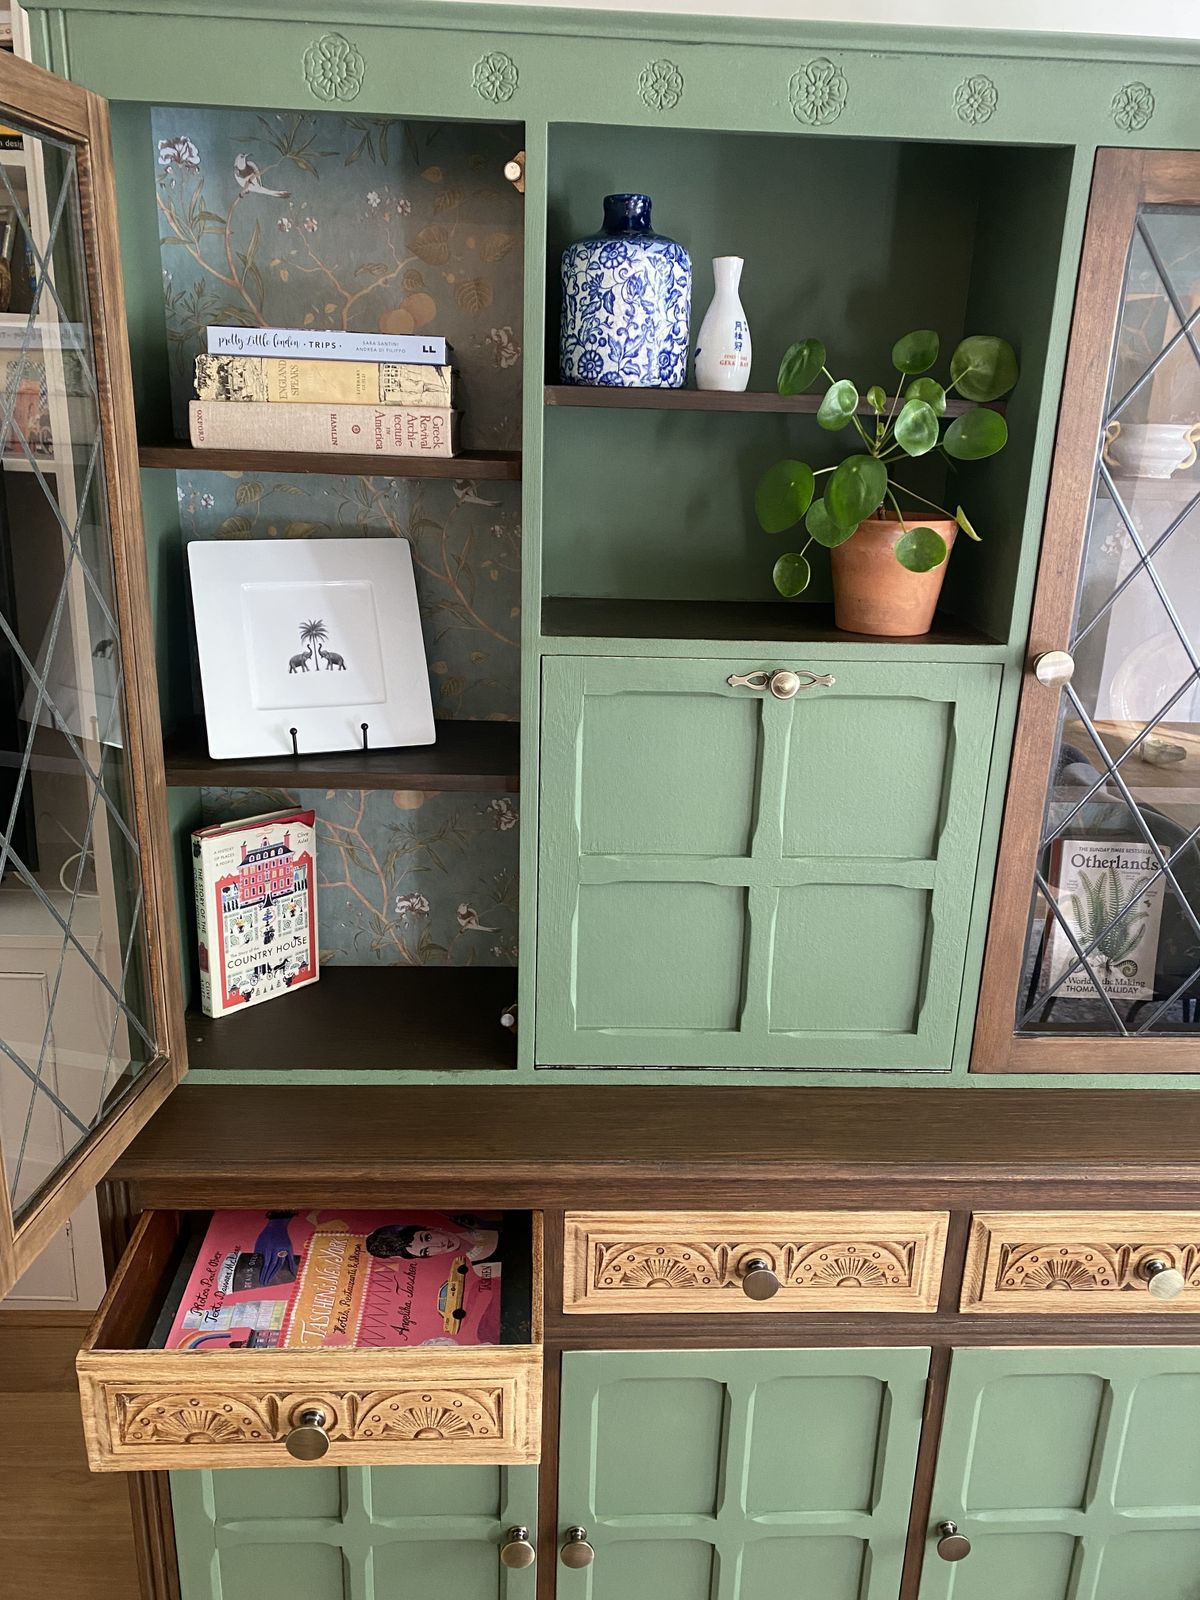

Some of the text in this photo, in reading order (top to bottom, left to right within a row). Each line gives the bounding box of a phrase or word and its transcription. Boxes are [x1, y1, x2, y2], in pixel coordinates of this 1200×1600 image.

[308, 341, 337, 349] TRIPS
[422, 345, 436, 353] LL
[278, 360, 288, 400] ENGLAND
[290, 364, 299, 396] SPEAKS
[197, 409, 205, 442] OXFORD
[330, 413, 338, 446] HAMLIN
[374, 409, 386, 450] America
[394, 414, 403, 447] tecture
[420, 415, 432, 450] Revival
[432, 415, 444, 449] Greek
[1071, 854, 1159, 871] Otherlands
[200, 908, 206, 918] OF
[227, 936, 308, 969] COUNTRY HOUSE
[1068, 977, 1091, 985] World
[1115, 978, 1146, 988] Making
[478, 1266, 492, 1293] TASCHEN
[190, 1288, 209, 1316] Photos
[205, 1302, 222, 1323] Texts
[390, 1262, 418, 1341] Angelika Taschen
